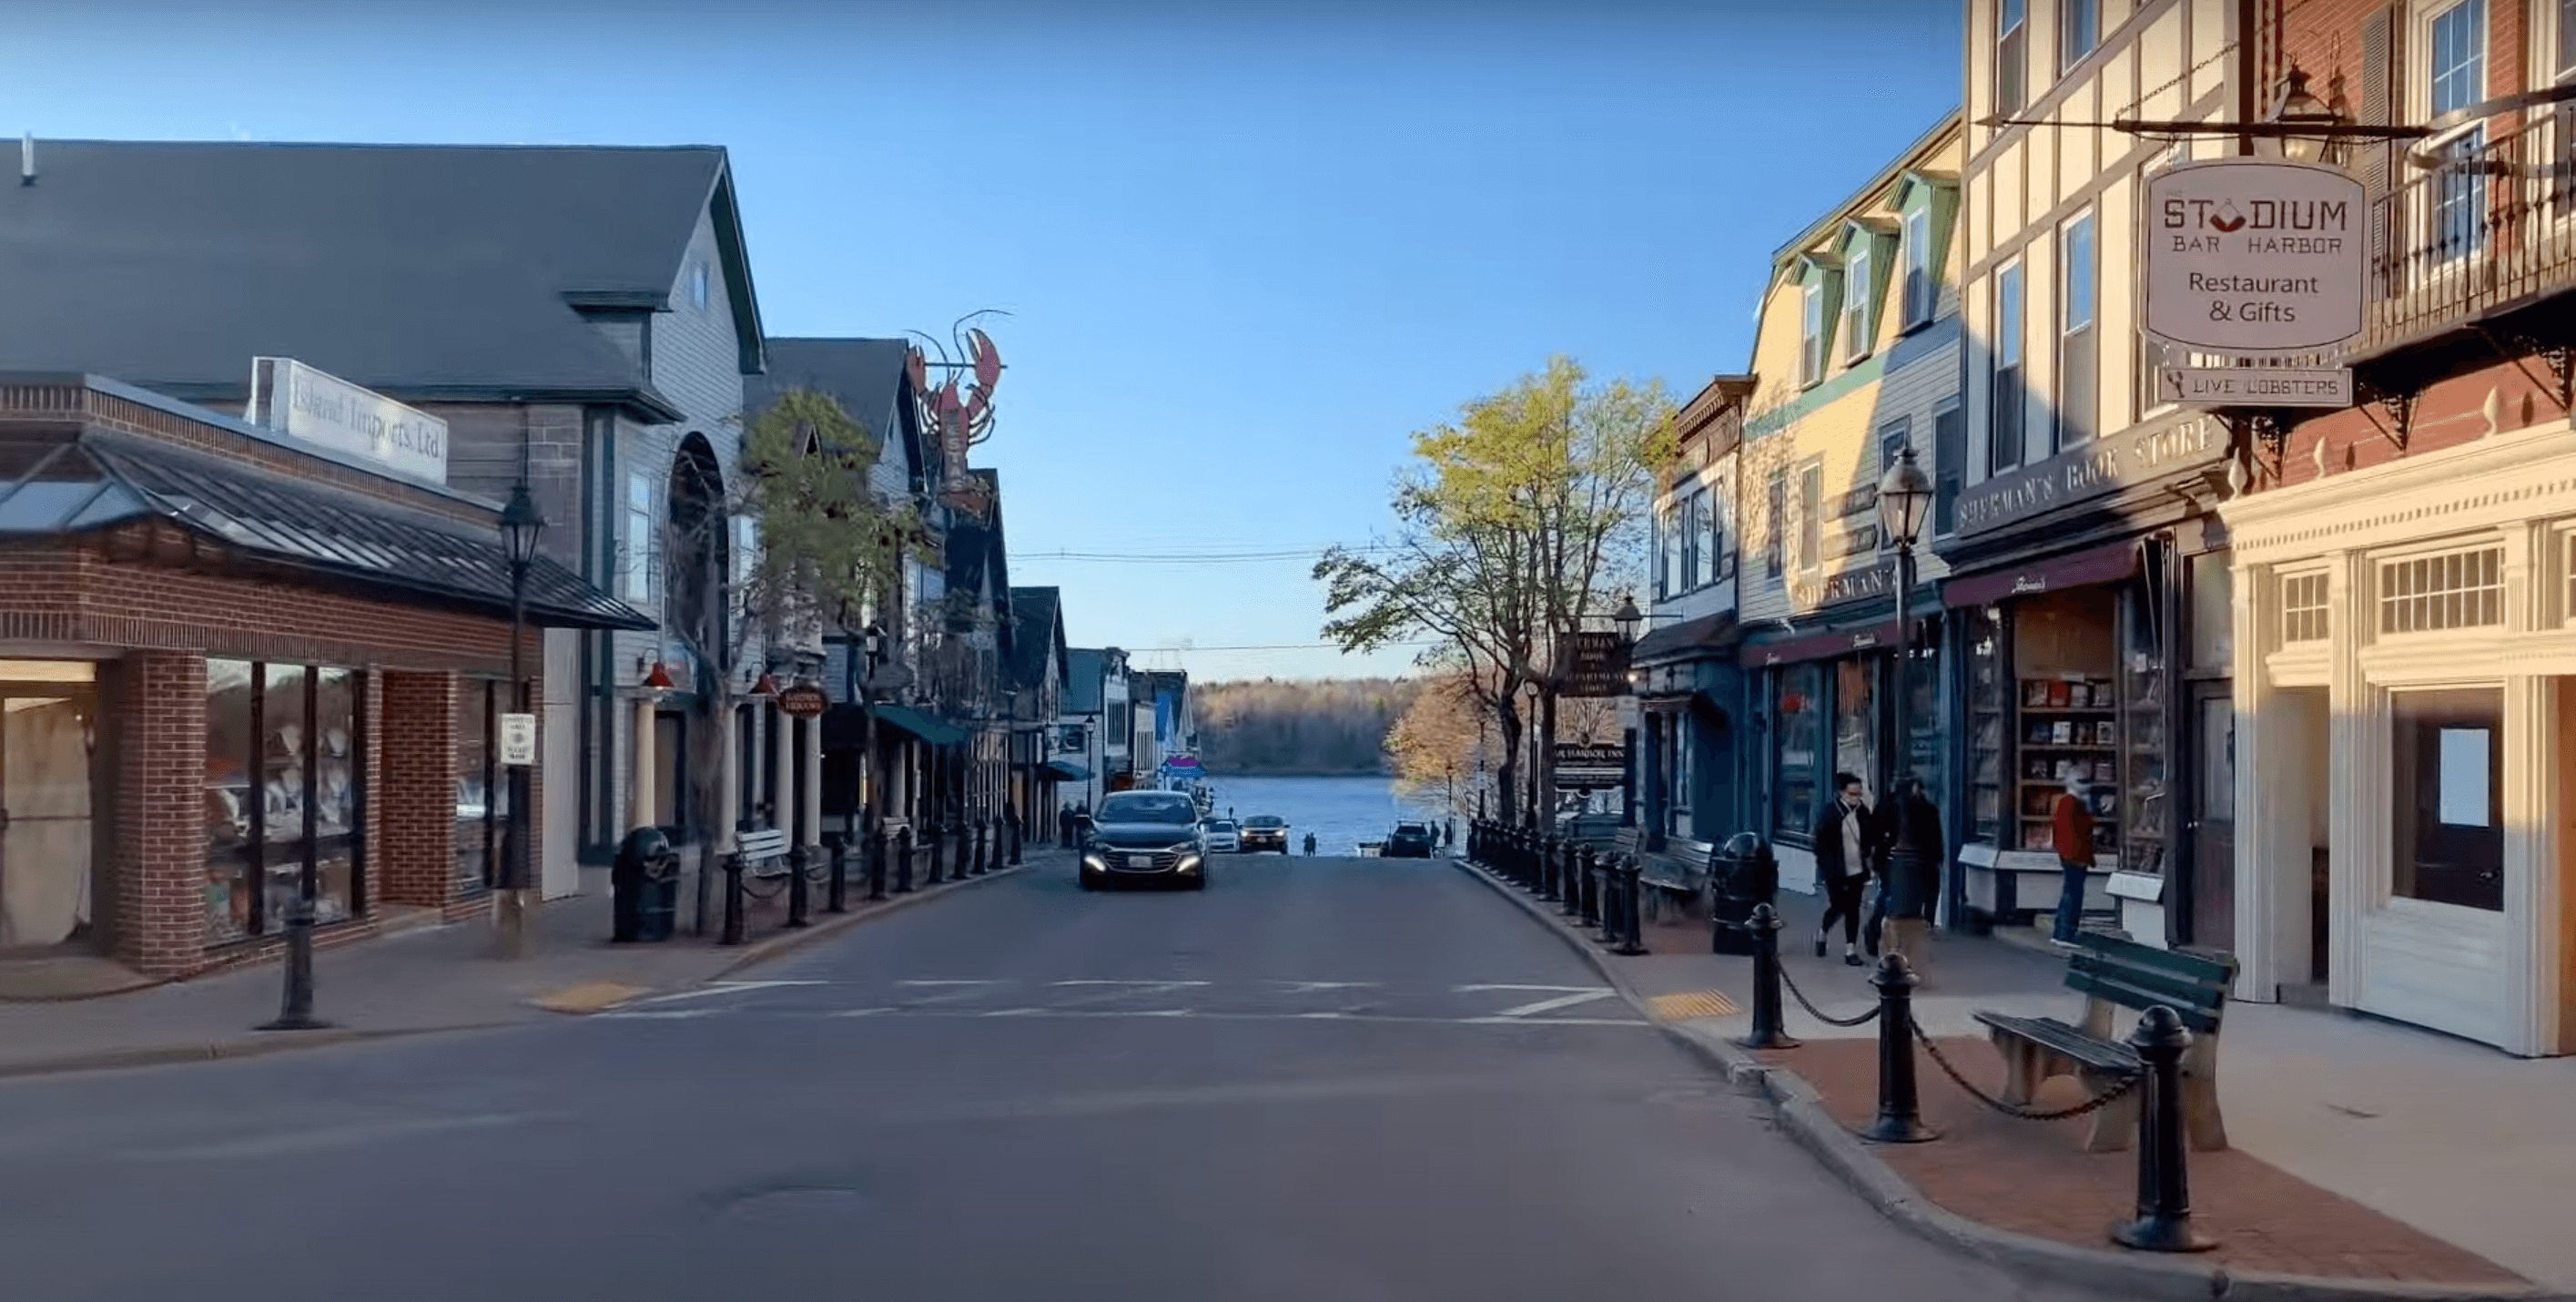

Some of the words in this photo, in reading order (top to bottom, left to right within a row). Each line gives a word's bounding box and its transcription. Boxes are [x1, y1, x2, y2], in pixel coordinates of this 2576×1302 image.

[2172, 235, 2220, 253] BAR
[2247, 237, 2343, 256] HARBOR
[2189, 272, 2319, 294] Restaurant
[2209, 300, 2233, 322] &
[2239, 301, 2296, 322] Gifts
[2193, 379, 2236, 393] LIVE
[2247, 379, 2338, 395] LOBSTERS
[294, 376, 345, 426] Island
[417, 421, 440, 458] Ltd
[1959, 474, 2053, 527] SHERMAN'S
[2065, 449, 2120, 492] BOOK
[2135, 414, 2214, 466] STORE
